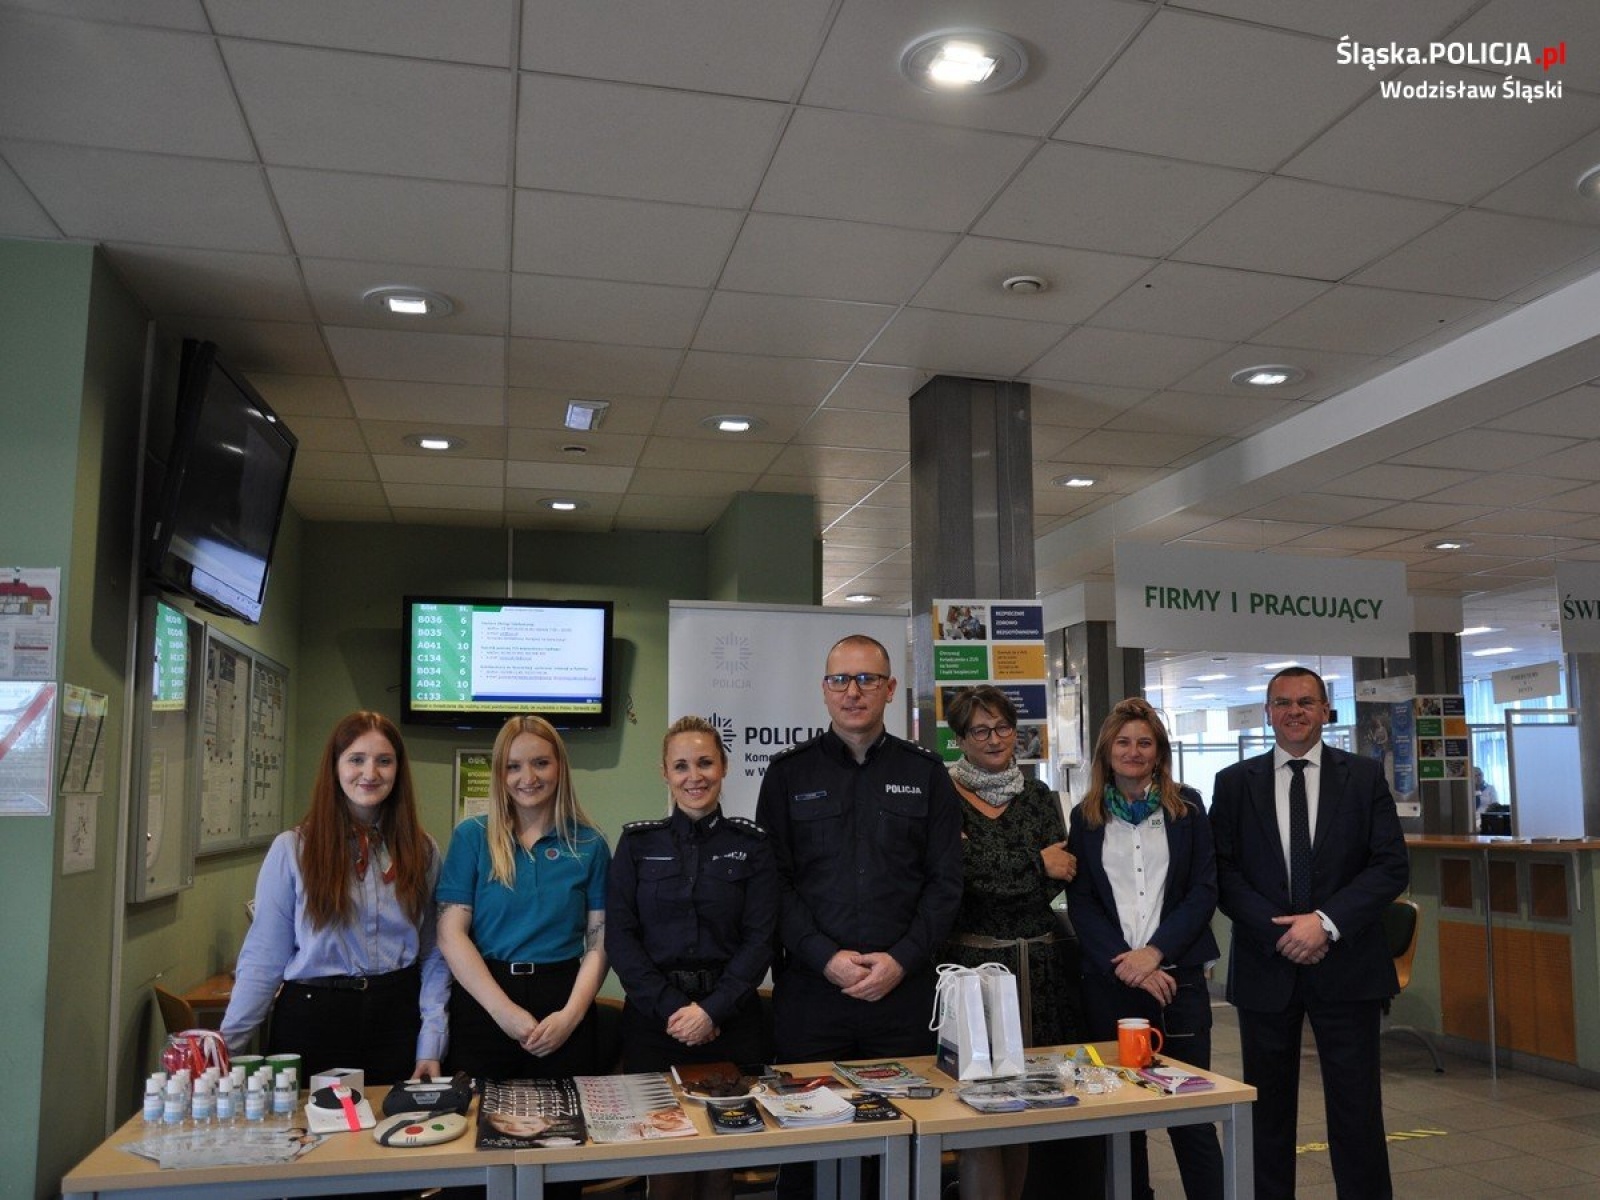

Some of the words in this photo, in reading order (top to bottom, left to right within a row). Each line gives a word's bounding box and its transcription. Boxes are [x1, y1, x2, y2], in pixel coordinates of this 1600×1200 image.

[1145, 585, 1220, 612] FIRMY
[1231, 591, 1238, 613] I
[1250, 592, 1384, 623] PRACUJĄCY
[416, 654, 441, 663] C134
[885, 783, 922, 795] POLICJA
